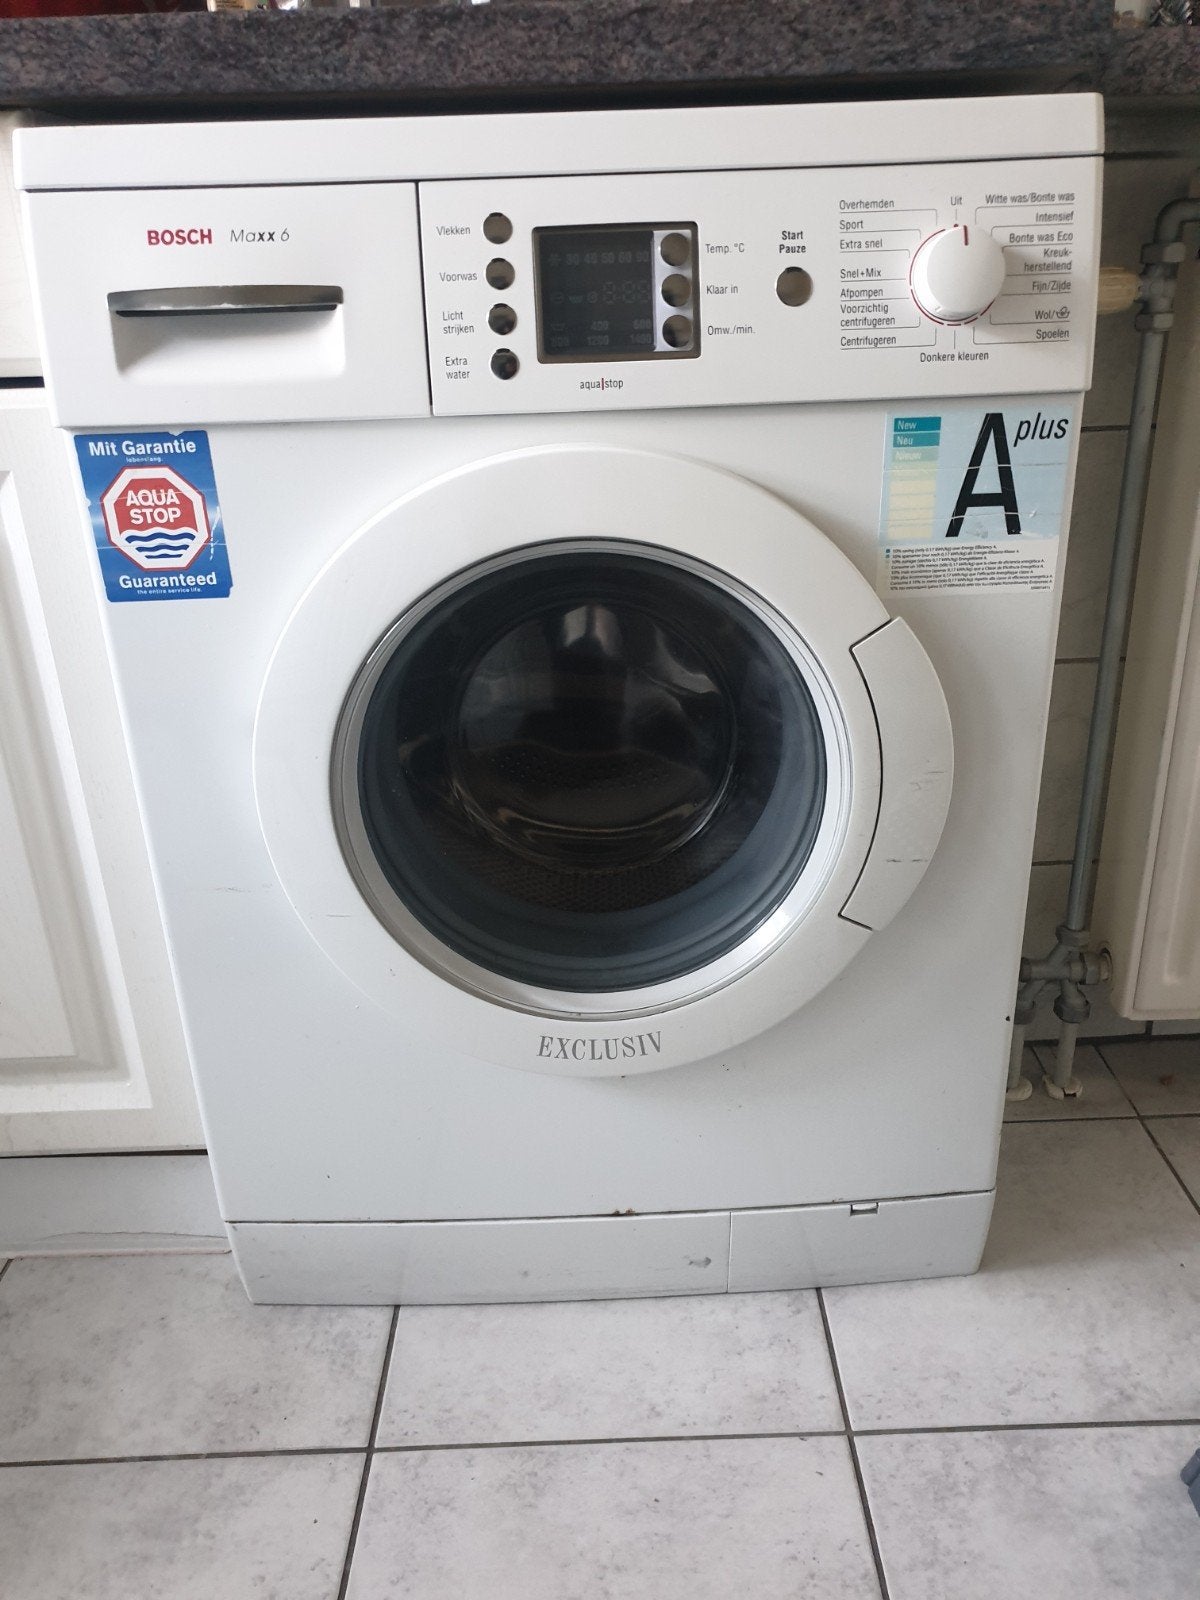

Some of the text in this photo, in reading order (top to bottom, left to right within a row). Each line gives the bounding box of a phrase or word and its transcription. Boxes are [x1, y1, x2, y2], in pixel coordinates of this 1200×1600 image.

[950, 196, 963, 206] Uit
[985, 194, 1008, 204] Witte
[1058, 192, 1075, 201] was
[839, 199, 895, 210] Overhemden
[1036, 211, 1074, 222] Intensief
[839, 220, 864, 230] Sport
[436, 226, 471, 236] Vlekken
[781, 230, 803, 240] Start
[147, 228, 290, 246] BOSCH Maxx 6
[1009, 231, 1073, 243] Bonte was Eco
[705, 243, 745, 254] Temp. °C
[779, 244, 806, 253] Pauze
[840, 238, 883, 249] Extra snel
[1043, 248, 1072, 258] Kreuk-
[1024, 260, 1072, 272] herstellend
[439, 272, 477, 282] Voorwas
[706, 285, 738, 295] Klaar in
[1032, 280, 1071, 292] Fijn/Zijde
[840, 288, 883, 299] Afpompen
[840, 303, 889, 314] Voorzichtig
[443, 311, 464, 321] Licht
[840, 316, 895, 328] centrifugeren
[443, 325, 474, 335] strijken
[1036, 328, 1069, 340] Spoelen
[840, 335, 896, 347] Centrifugeren
[445, 357, 468, 366] Extra
[920, 352, 989, 362] Donkere kleuren
[446, 370, 470, 379] water
[897, 420, 917, 430] New
[897, 435, 913, 445] Neu
[89, 439, 196, 456] Mit Garantie
[945, 412, 1069, 538] A plus
[126, 489, 180, 507] AQUA
[129, 507, 181, 525] STOP
[119, 571, 217, 589] Guaranteed
[536, 1031, 661, 1061] EXCLUSIV
